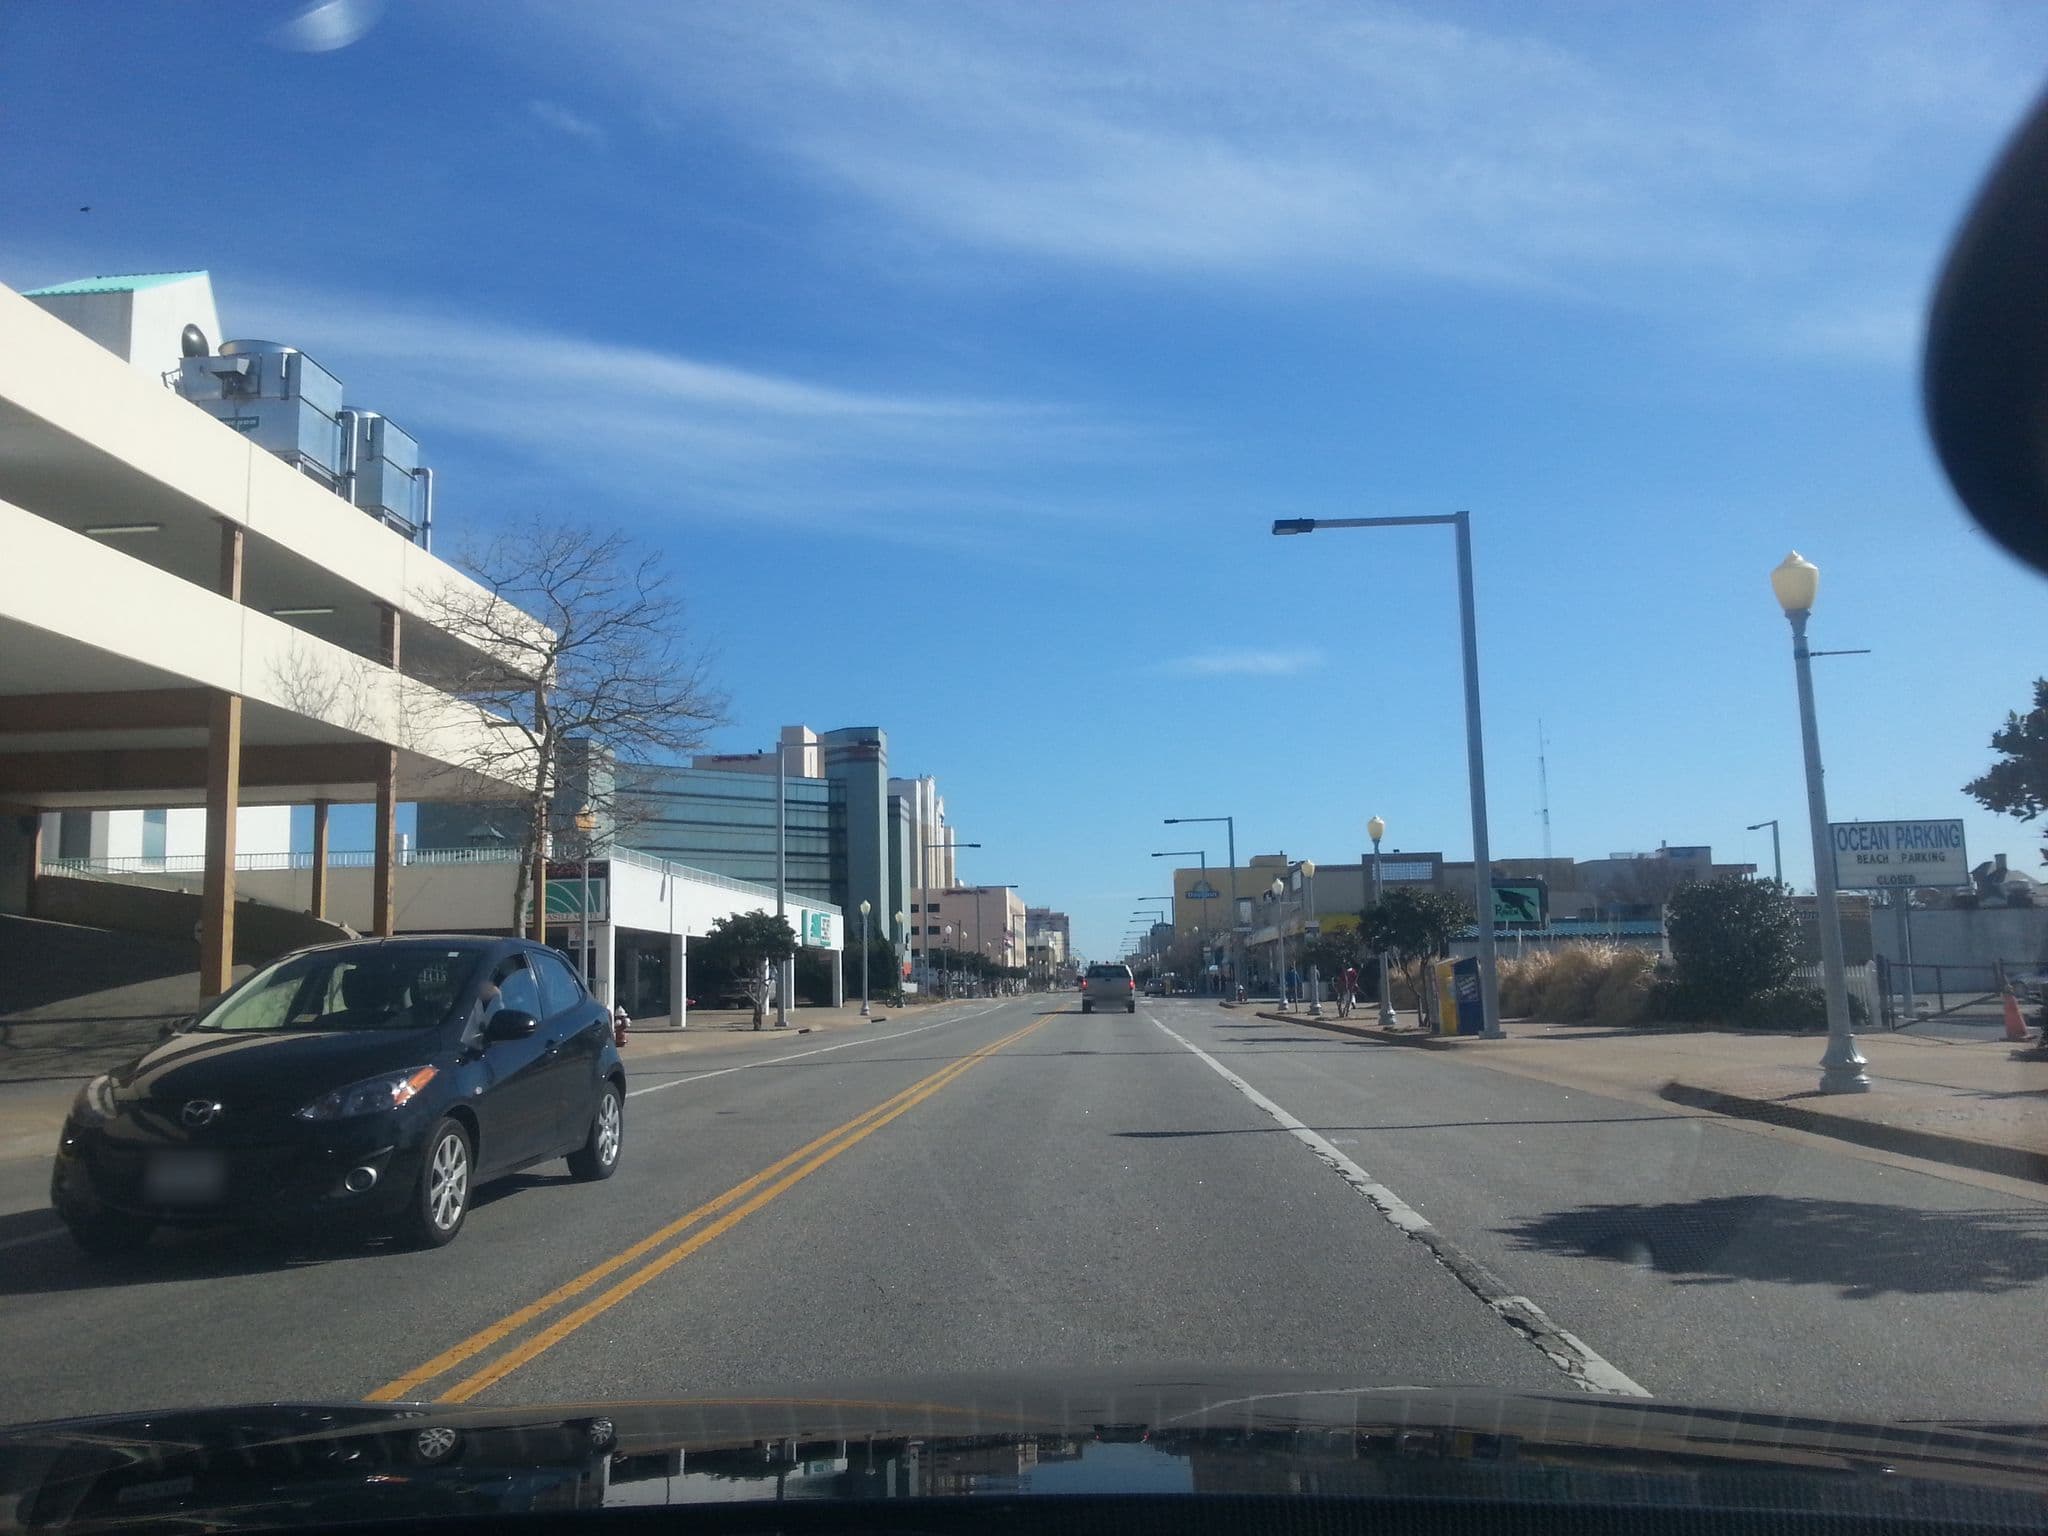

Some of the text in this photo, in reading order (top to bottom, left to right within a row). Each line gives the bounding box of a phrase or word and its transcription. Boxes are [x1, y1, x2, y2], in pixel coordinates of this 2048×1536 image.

[1837, 824, 1961, 851] OCEAN PARKING
[1857, 851, 1945, 864] BEACH PARKING
